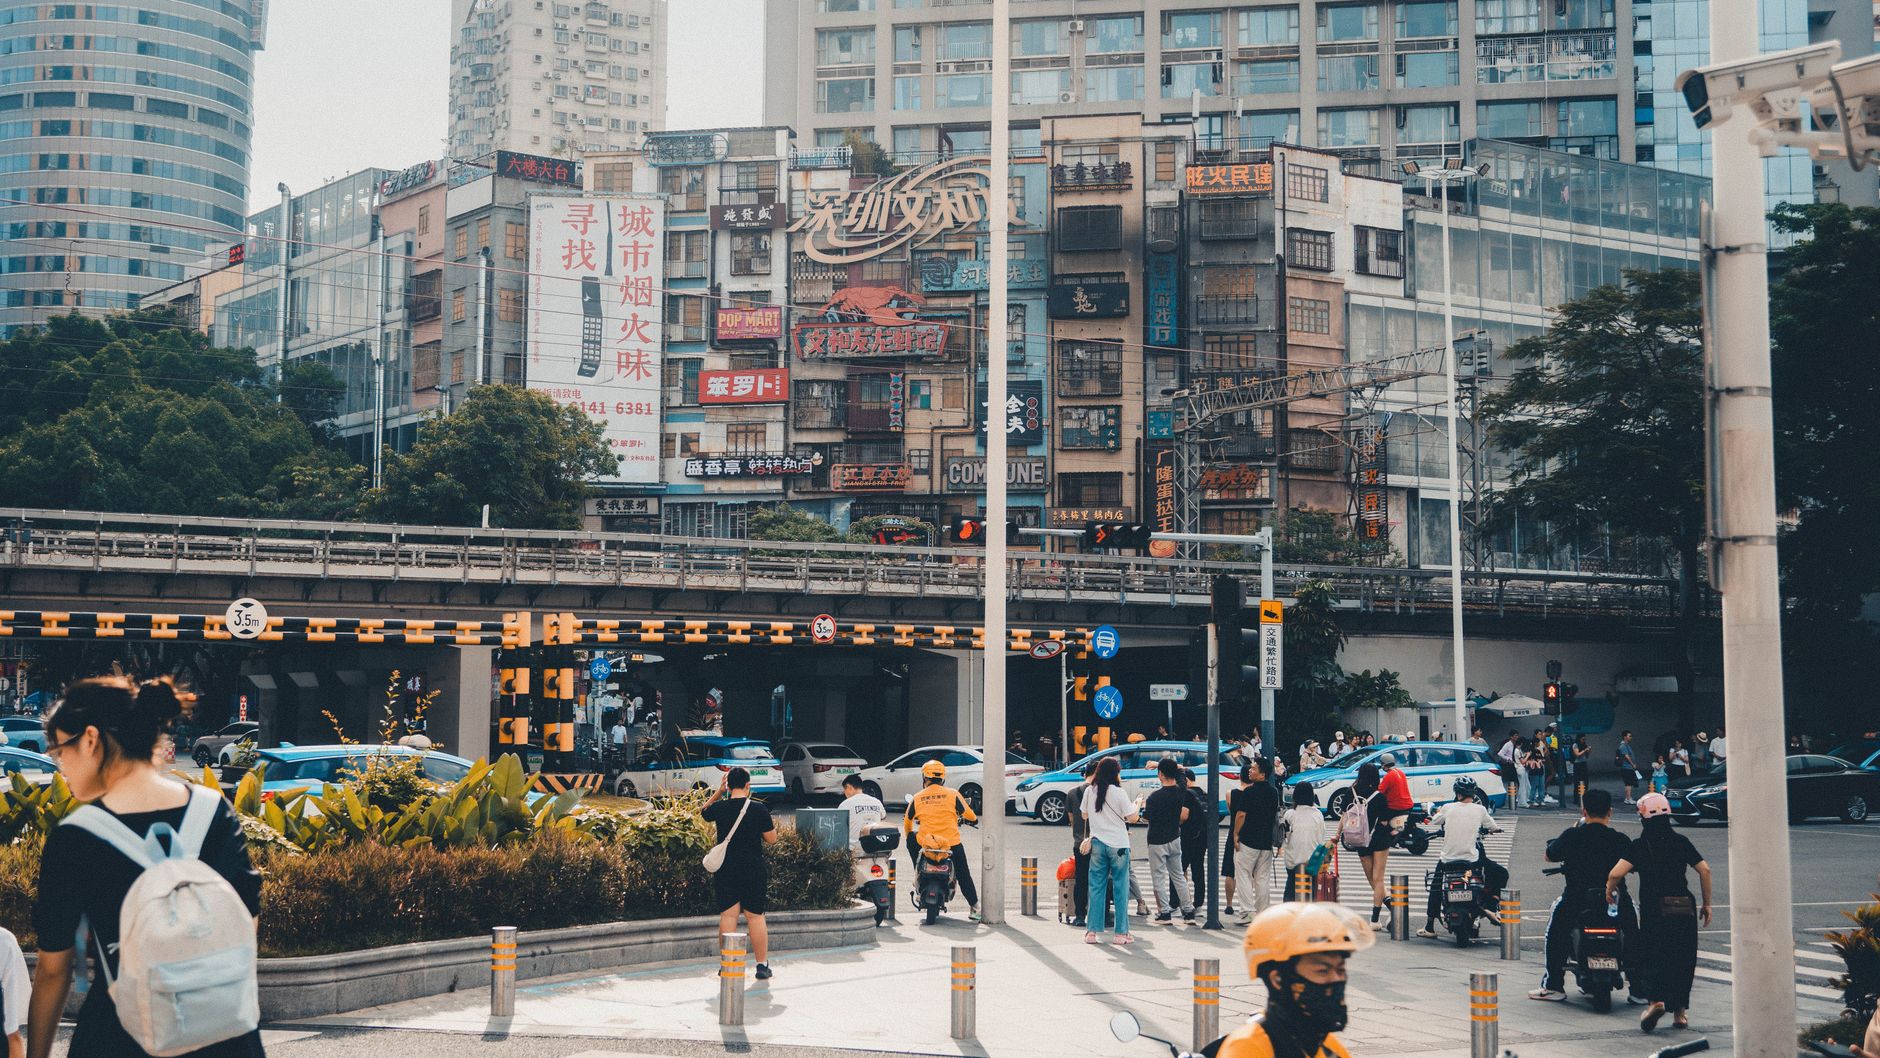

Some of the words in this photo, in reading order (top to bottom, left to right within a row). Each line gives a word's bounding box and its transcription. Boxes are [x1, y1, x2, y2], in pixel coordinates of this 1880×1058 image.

[506, 156, 569, 181] 六楼天台
[562, 204, 598, 271] 寻找
[961, 265, 1044, 284] 河先生
[617, 205, 656, 382] 城市烟火味
[719, 312, 742, 328] POP
[745, 309, 780, 327] MART
[804, 328, 938, 353] 文和友龙虾馆
[707, 375, 773, 397] 笨罗卜
[615, 402, 653, 415] 6381
[982, 394, 1025, 413] 全
[982, 416, 1026, 433] 夫
[686, 459, 740, 476] 盛香亭
[949, 462, 1044, 485] COMUNE
[1156, 449, 1174, 532] 广隆蛋挞王
[234, 609, 260, 627] 3.5m
[816, 622, 832, 634] 3.5m
[1266, 627, 1277, 686] 交通繁忙路段
